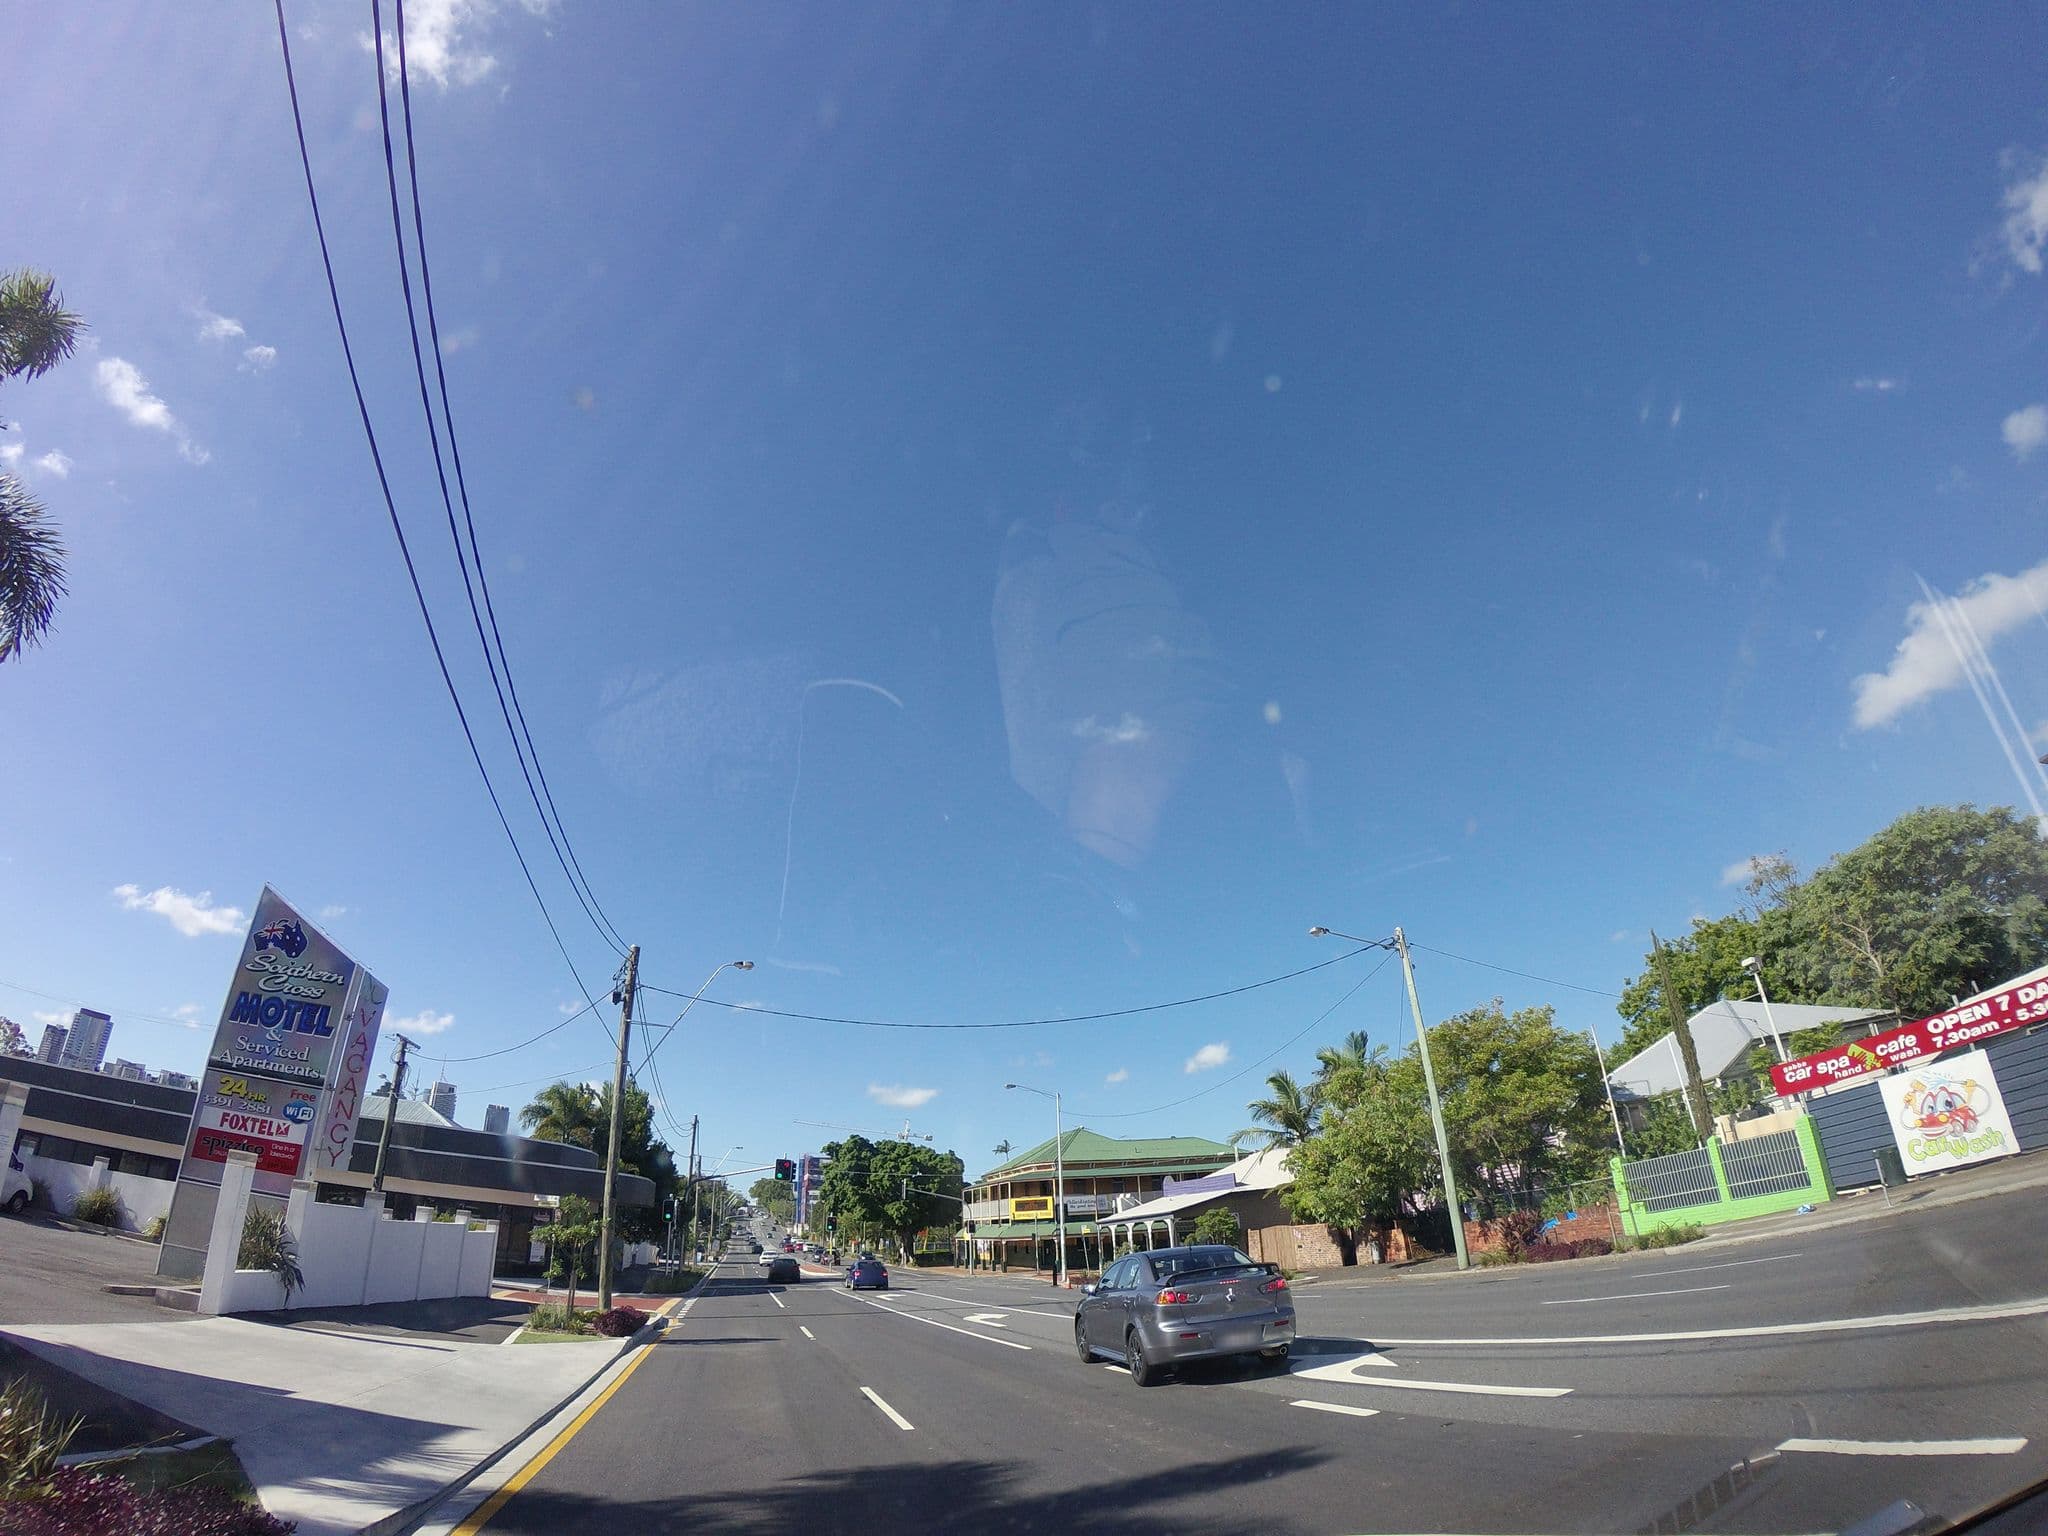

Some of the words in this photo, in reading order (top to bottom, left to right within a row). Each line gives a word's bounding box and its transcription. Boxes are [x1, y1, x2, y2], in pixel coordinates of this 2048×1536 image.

[245, 954, 344, 985] Southern
[258, 974, 326, 999] Cross
[228, 992, 335, 1039] MOTEL
[1926, 1002, 1992, 1034] OPEN
[1995, 995, 2010, 1011] 7
[2016, 980, 2048, 1005] DA
[266, 1028, 283, 1042] &
[1932, 1020, 2000, 1048] 7.30am
[2015, 999, 2048, 1021] 5.3
[219, 1048, 321, 1079] Apartments
[235, 1035, 311, 1061] Serviced
[1784, 1066, 1812, 1083] car
[1816, 1055, 1850, 1074] spa
[1875, 1034, 1917, 1056] cafe
[1835, 1064, 1862, 1079] hand
[1890, 1047, 1921, 1062] wash
[202, 1094, 233, 1107] 3391
[217, 1076, 249, 1099] 24
[289, 1089, 317, 1102] Free
[328, 1007, 377, 1168] VACANCY
[220, 1112, 275, 1136] FOXTEL
